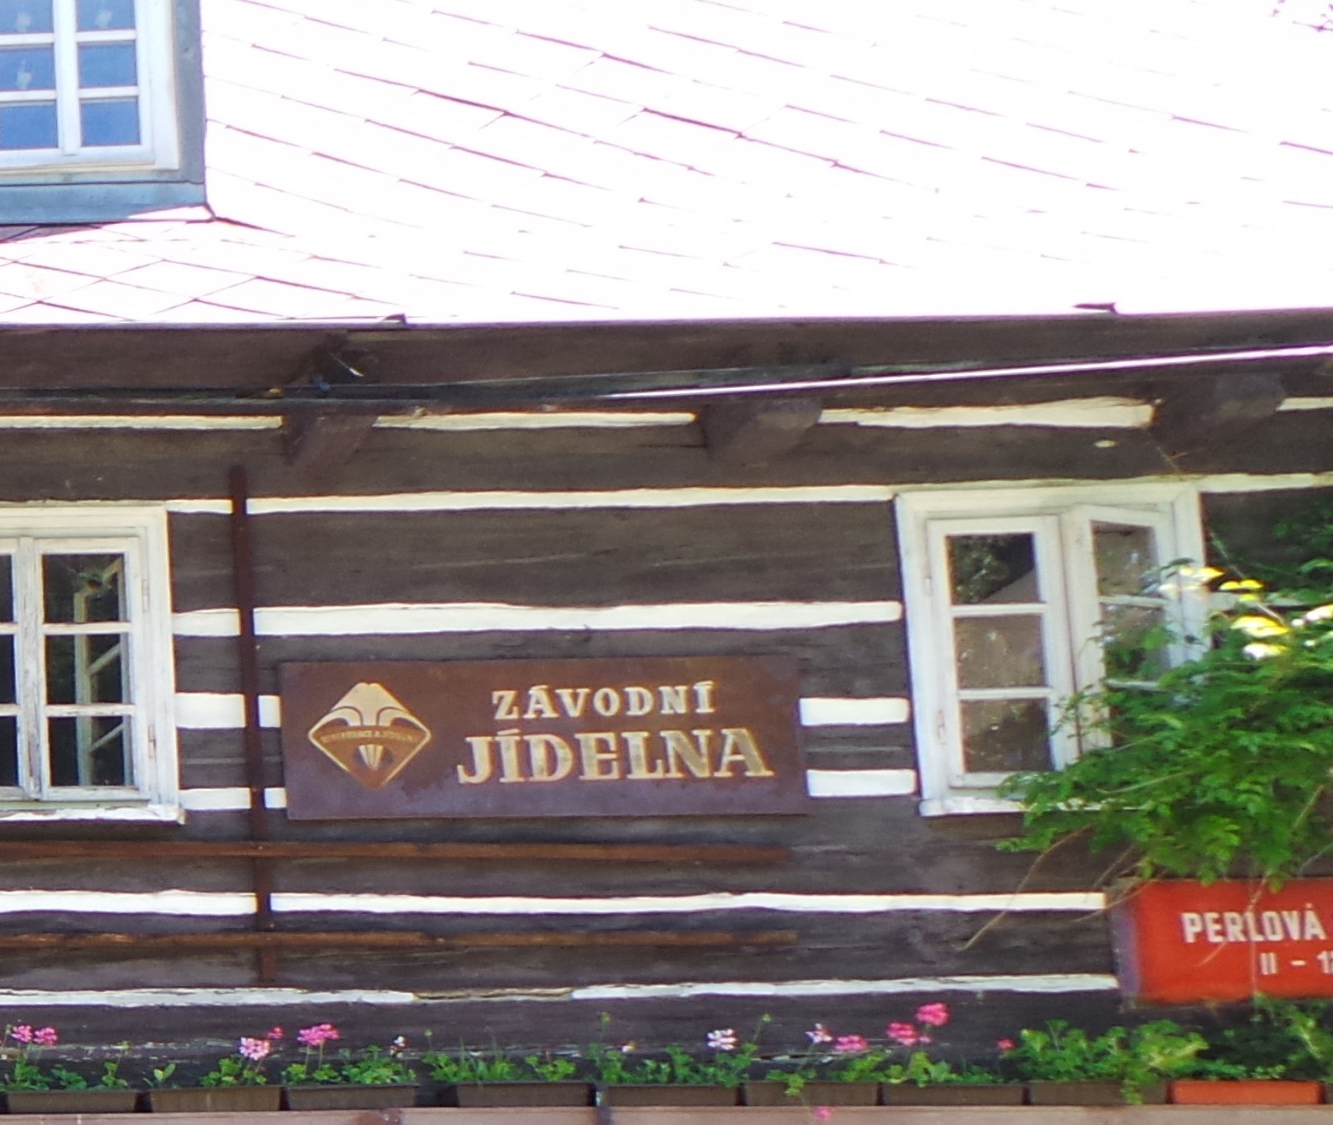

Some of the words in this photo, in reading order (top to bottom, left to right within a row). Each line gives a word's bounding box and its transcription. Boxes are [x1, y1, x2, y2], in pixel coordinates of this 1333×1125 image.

[491, 681, 716, 720] ZÁVODNÍ
[457, 728, 775, 784] JÍDELNA
[1181, 903, 1327, 943] PERLOVÁ
